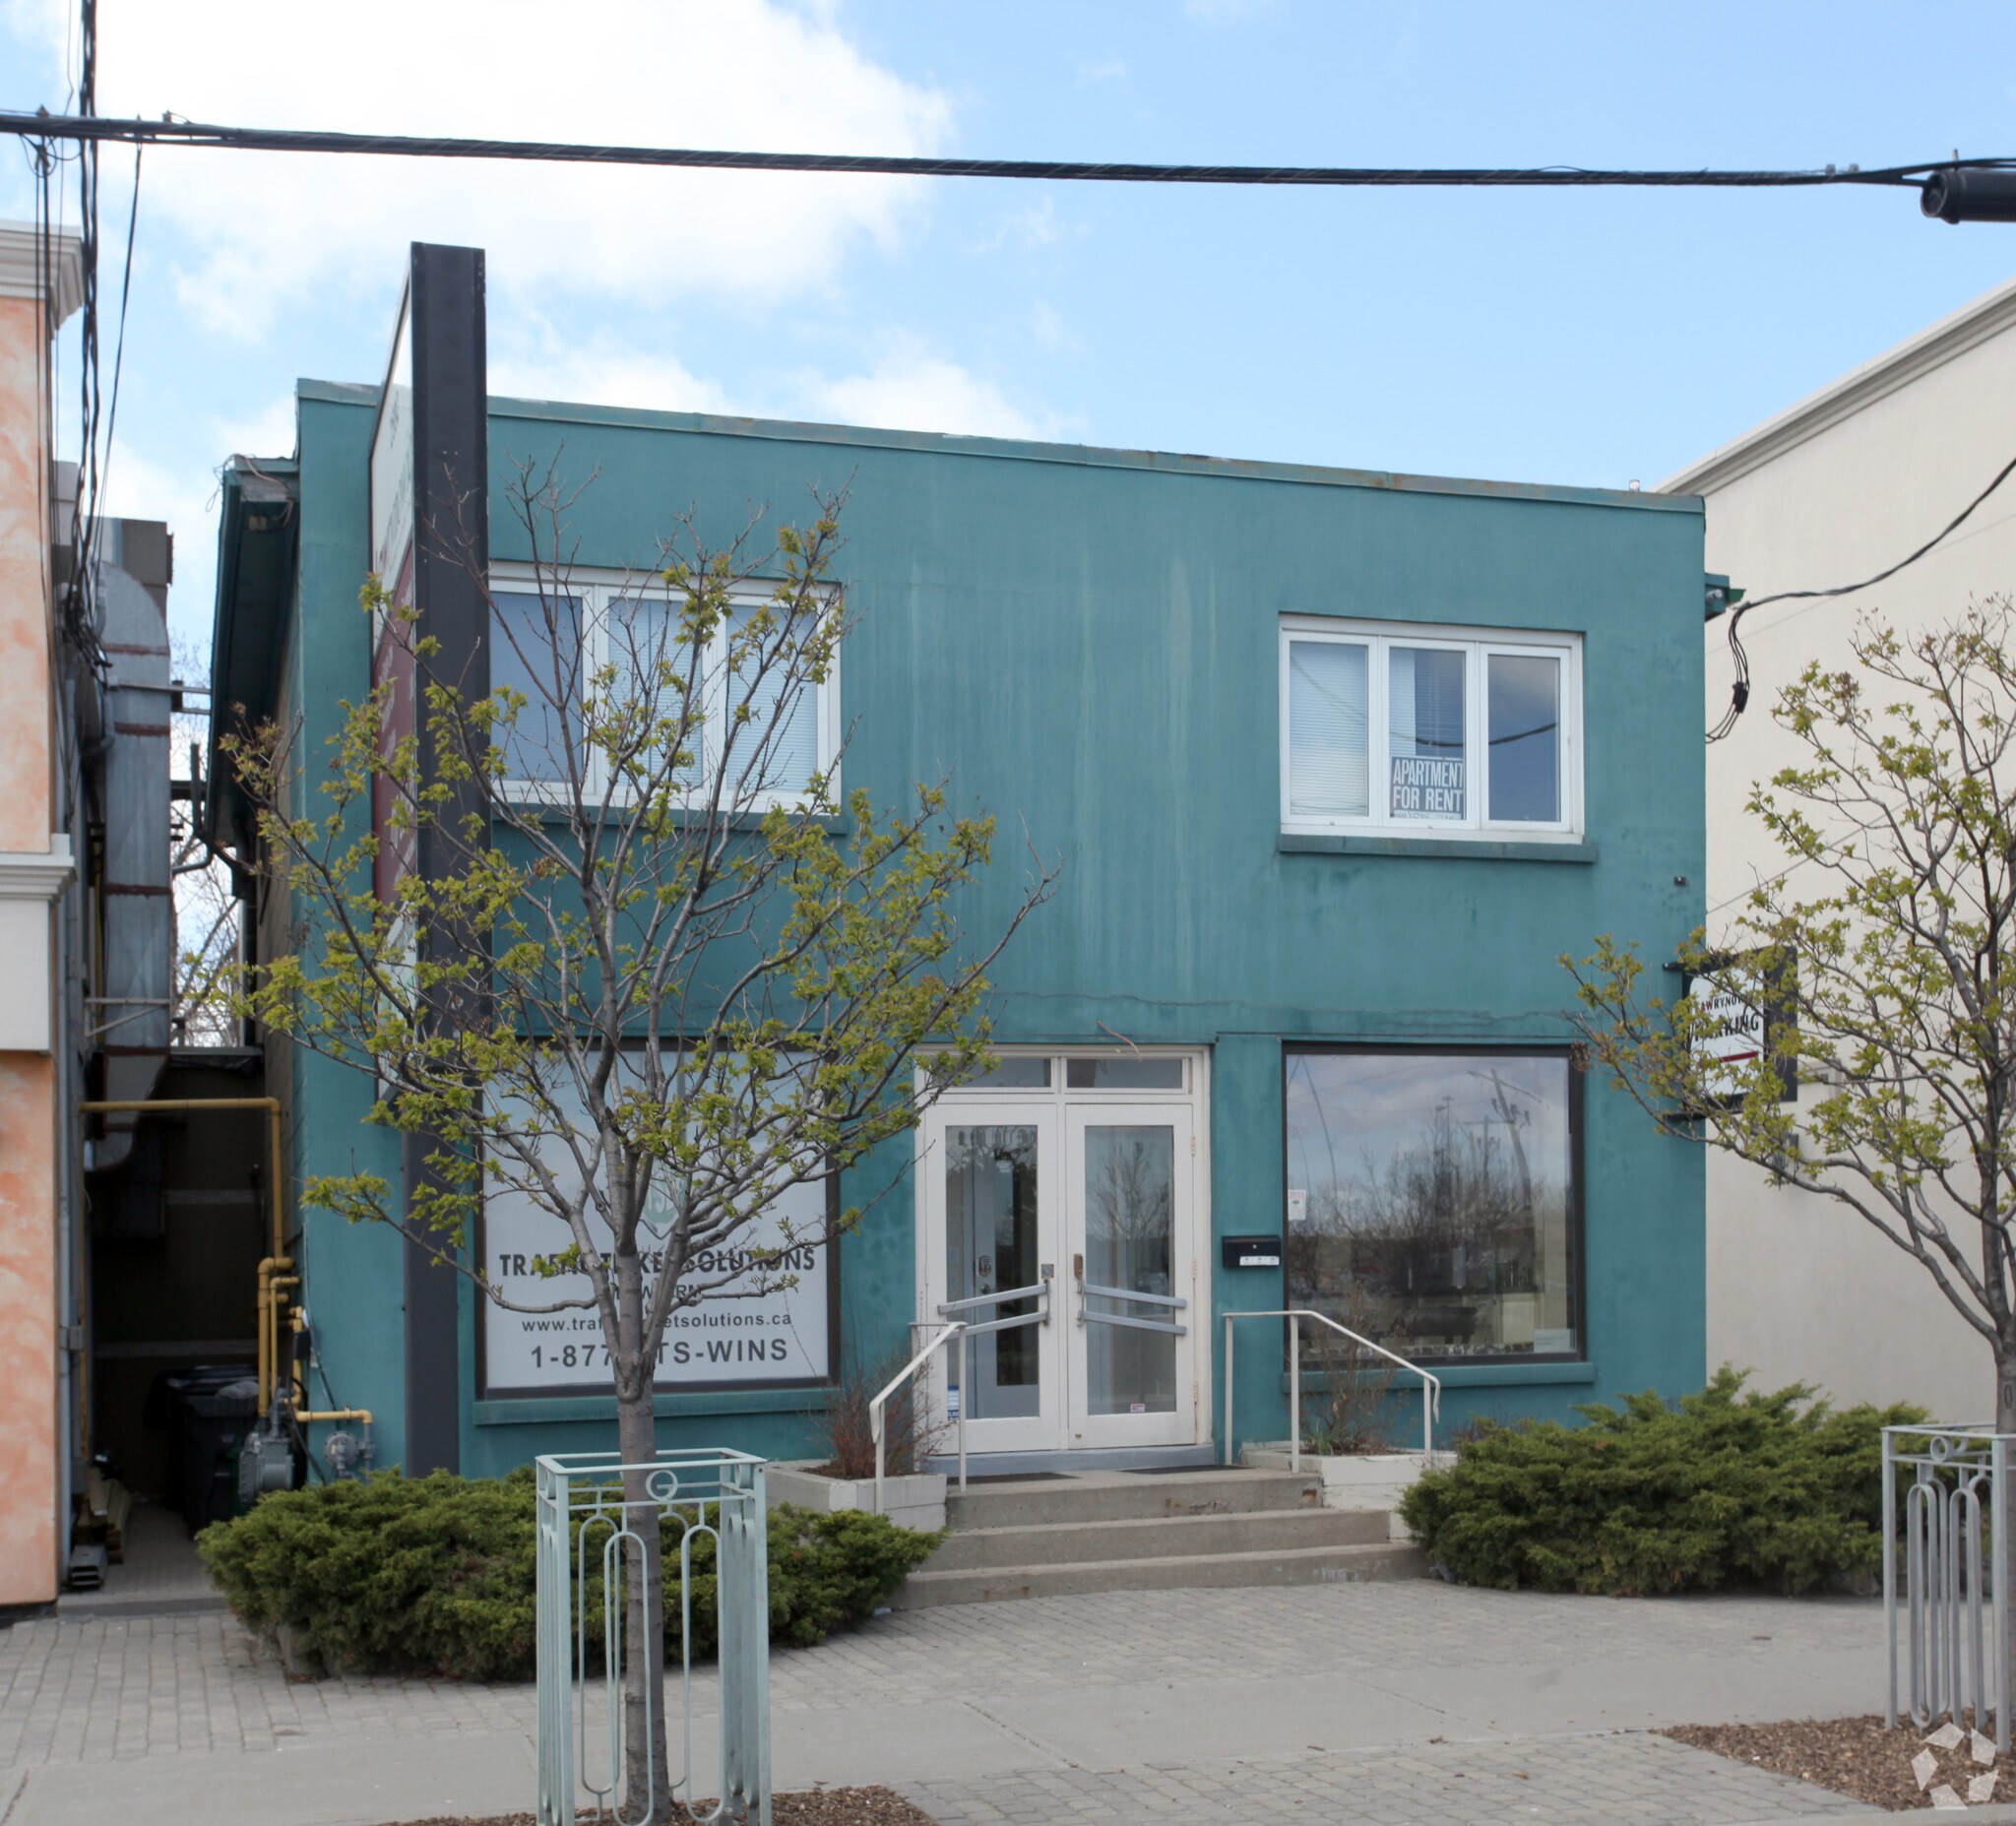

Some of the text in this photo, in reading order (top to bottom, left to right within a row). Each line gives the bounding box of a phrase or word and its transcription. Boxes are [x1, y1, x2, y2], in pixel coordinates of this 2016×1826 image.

[1393, 758, 1464, 788] APARTMENT
[1392, 785, 1464, 812] FOR RENT
[1694, 1013, 1760, 1041] KING
[499, 1252, 591, 1277] TRAF
[521, 1311, 792, 1333] www.trafetsolutions.ca
[531, 1338, 788, 1368] 1-877TS-WINS
